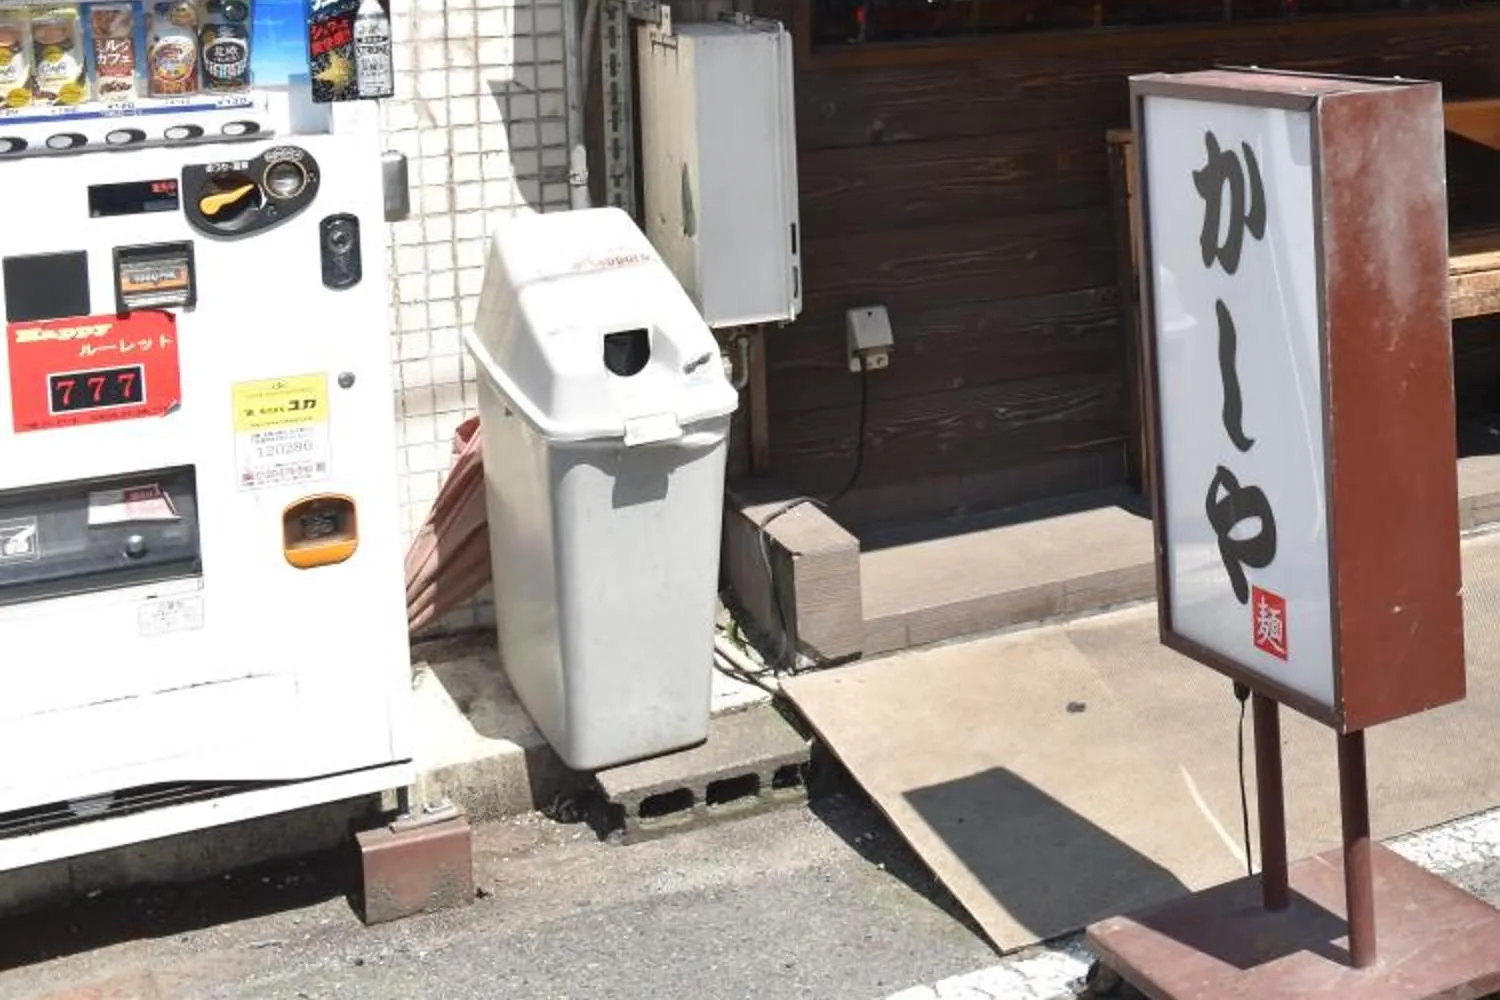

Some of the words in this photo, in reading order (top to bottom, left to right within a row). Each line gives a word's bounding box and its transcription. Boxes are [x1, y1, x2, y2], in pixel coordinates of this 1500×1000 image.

[79, 333, 174, 357] ルーレット
[1192, 130, 1277, 605] かしや
[1255, 592, 1286, 656] 麺
